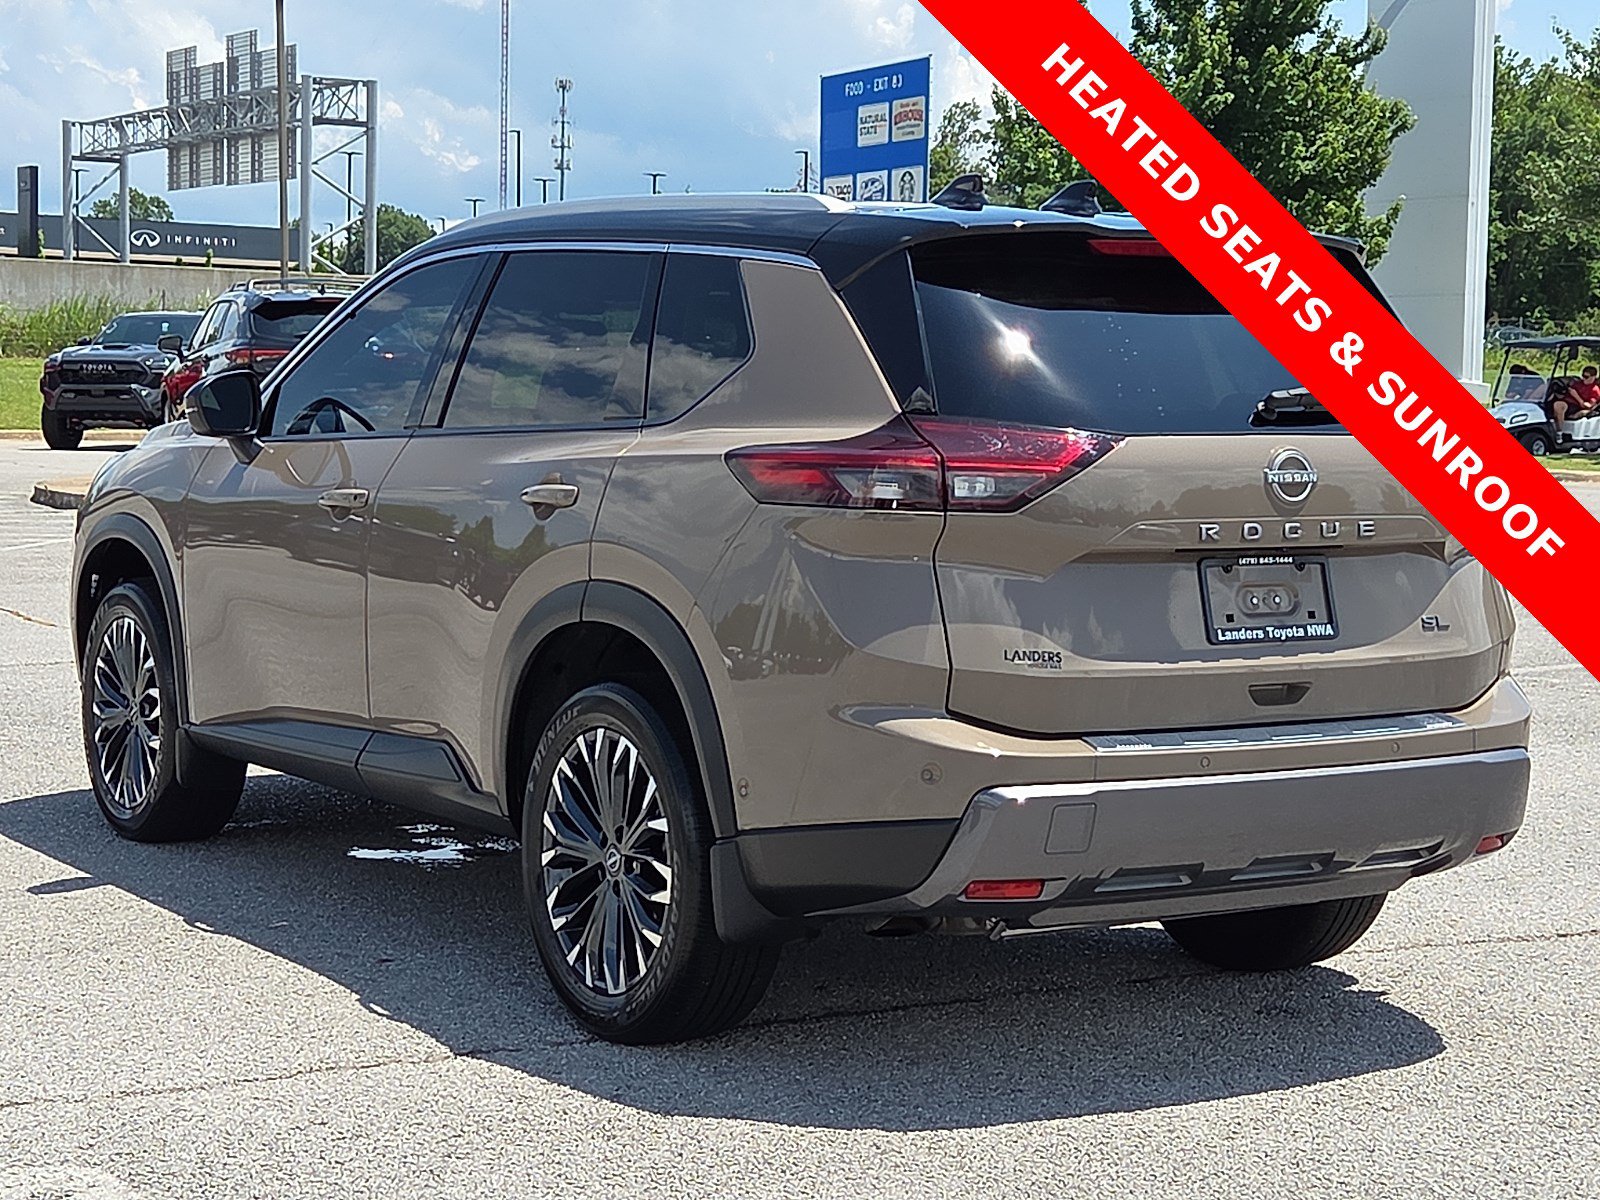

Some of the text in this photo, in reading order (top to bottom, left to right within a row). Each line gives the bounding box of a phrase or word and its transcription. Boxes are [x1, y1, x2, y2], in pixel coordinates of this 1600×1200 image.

[845, 81, 864, 97] FOOD
[873, 77, 888, 92] EXIT
[860, 112, 888, 125] NATURAL
[859, 125, 878, 137] STATE
[835, 184, 852, 196] TACO
[166, 234, 237, 247] INFINITI
[82, 363, 114, 373] TOYOTA
[1267, 473, 1317, 484] NISSAN
[1199, 520, 1377, 542] ROGUE
[1421, 615, 1450, 632] SL
[1217, 624, 1334, 641] Landers Toyota NWA
[1004, 649, 1063, 664] LANDERS
